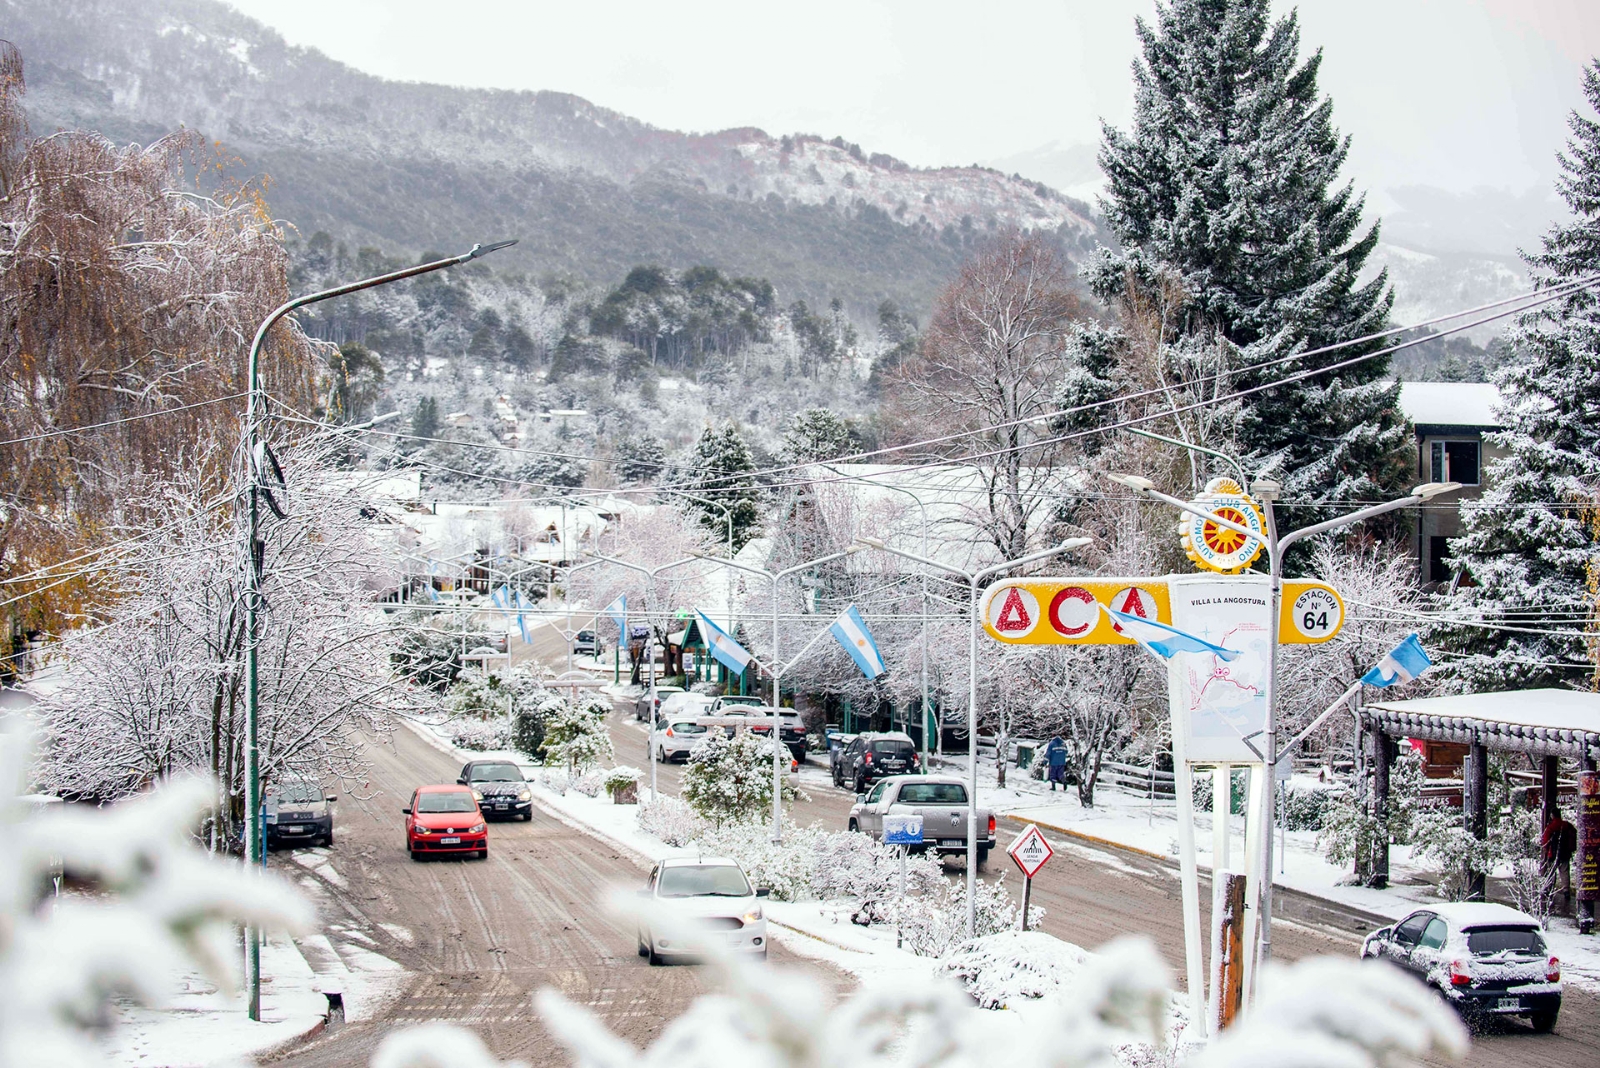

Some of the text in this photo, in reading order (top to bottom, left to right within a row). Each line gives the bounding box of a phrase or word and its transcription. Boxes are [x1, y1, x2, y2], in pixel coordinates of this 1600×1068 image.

[1213, 498, 1240, 509] CLUB
[1238, 506, 1260, 562] ARGETINO
[1190, 598, 1211, 606] VILLA
[1223, 597, 1267, 606] ANGOSTURA
[1295, 590, 1338, 610] ESTACION
[995, 586, 1150, 635] ACA
[1303, 611, 1329, 630] 64
